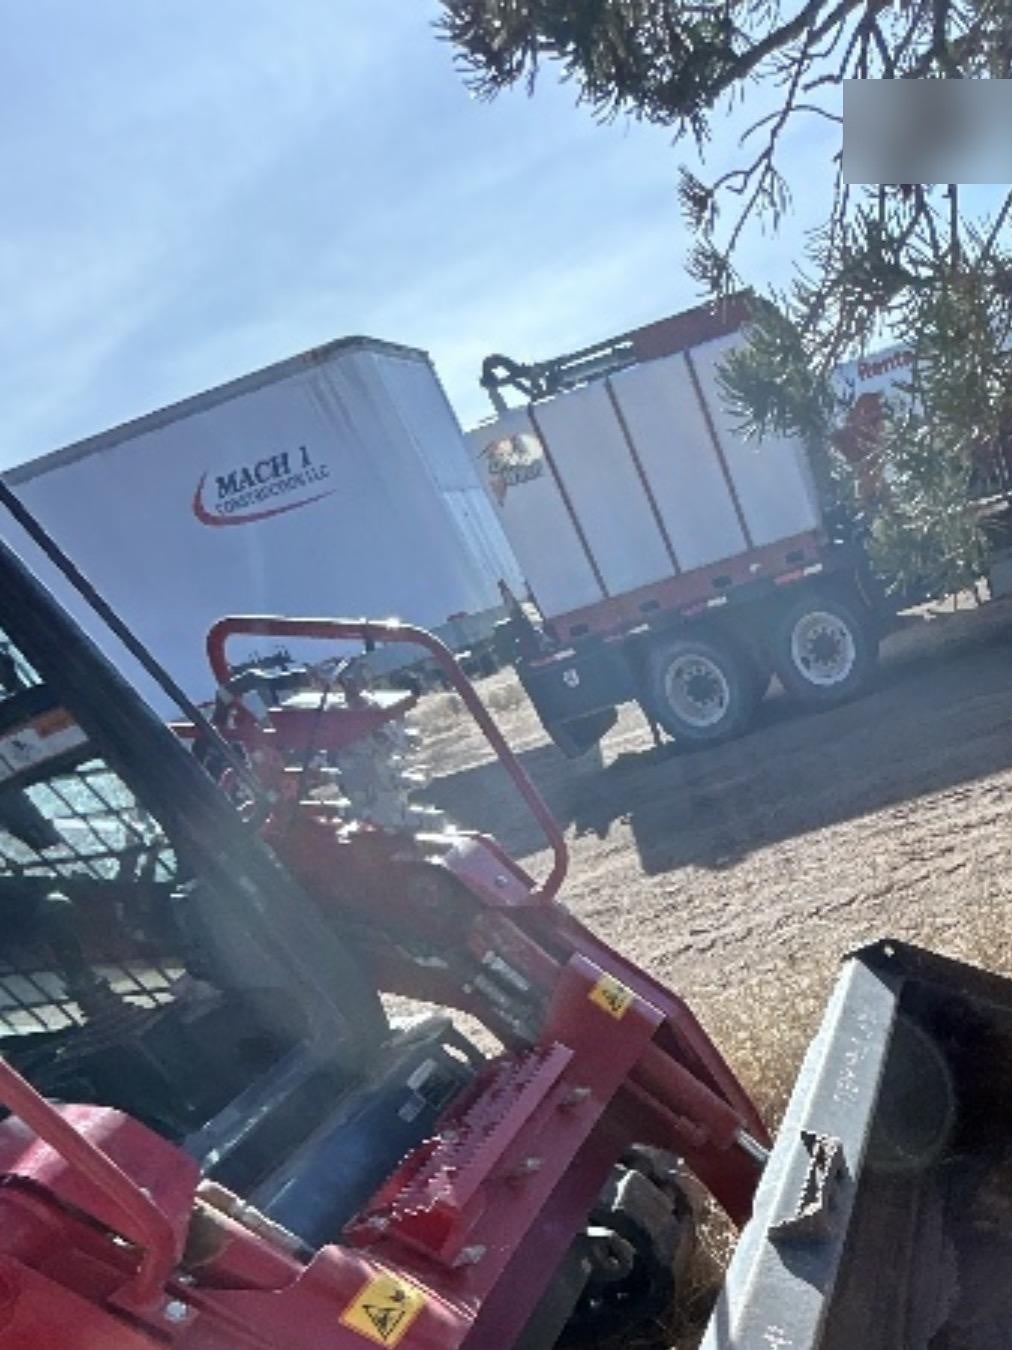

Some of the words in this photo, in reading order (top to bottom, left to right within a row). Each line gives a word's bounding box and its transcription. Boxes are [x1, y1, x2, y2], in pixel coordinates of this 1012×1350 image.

[857, 350, 915, 381] Renta
[215, 452, 291, 499] MACH
[299, 445, 312, 468] 1
